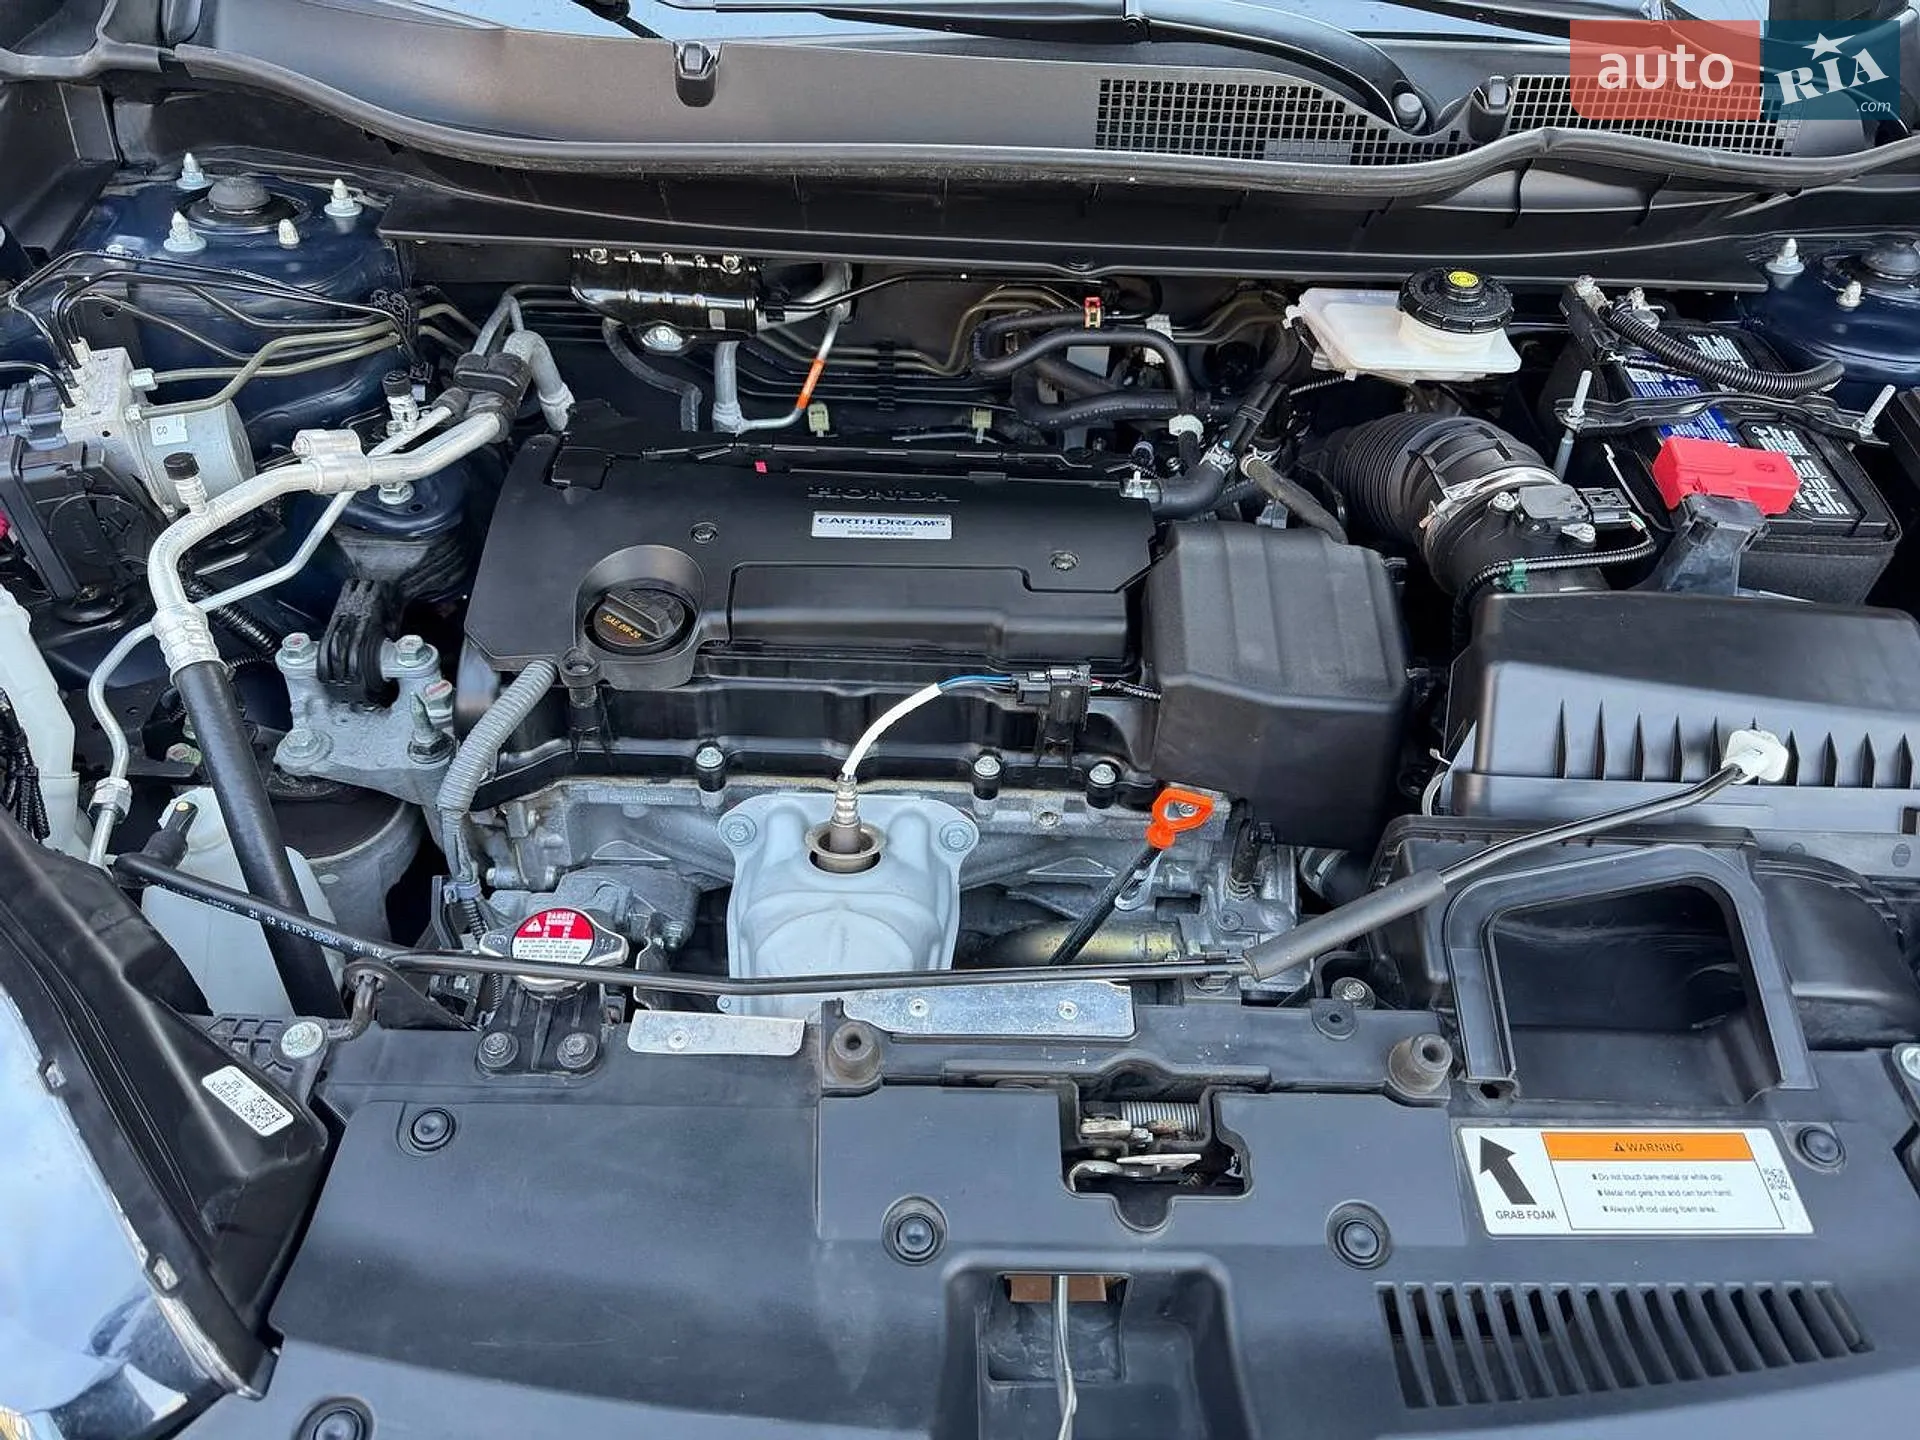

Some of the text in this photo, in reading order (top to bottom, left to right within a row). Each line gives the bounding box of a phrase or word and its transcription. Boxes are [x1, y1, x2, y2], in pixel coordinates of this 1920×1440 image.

[818, 517, 873, 526] EARTH
[877, 518, 946, 527] DREAMS
[1626, 1143, 1684, 1152] WARNING
[1598, 1172, 1609, 1181] Do
[1622, 1172, 1641, 1181] touch
[1496, 1209, 1557, 1219] GRAB FOAM
